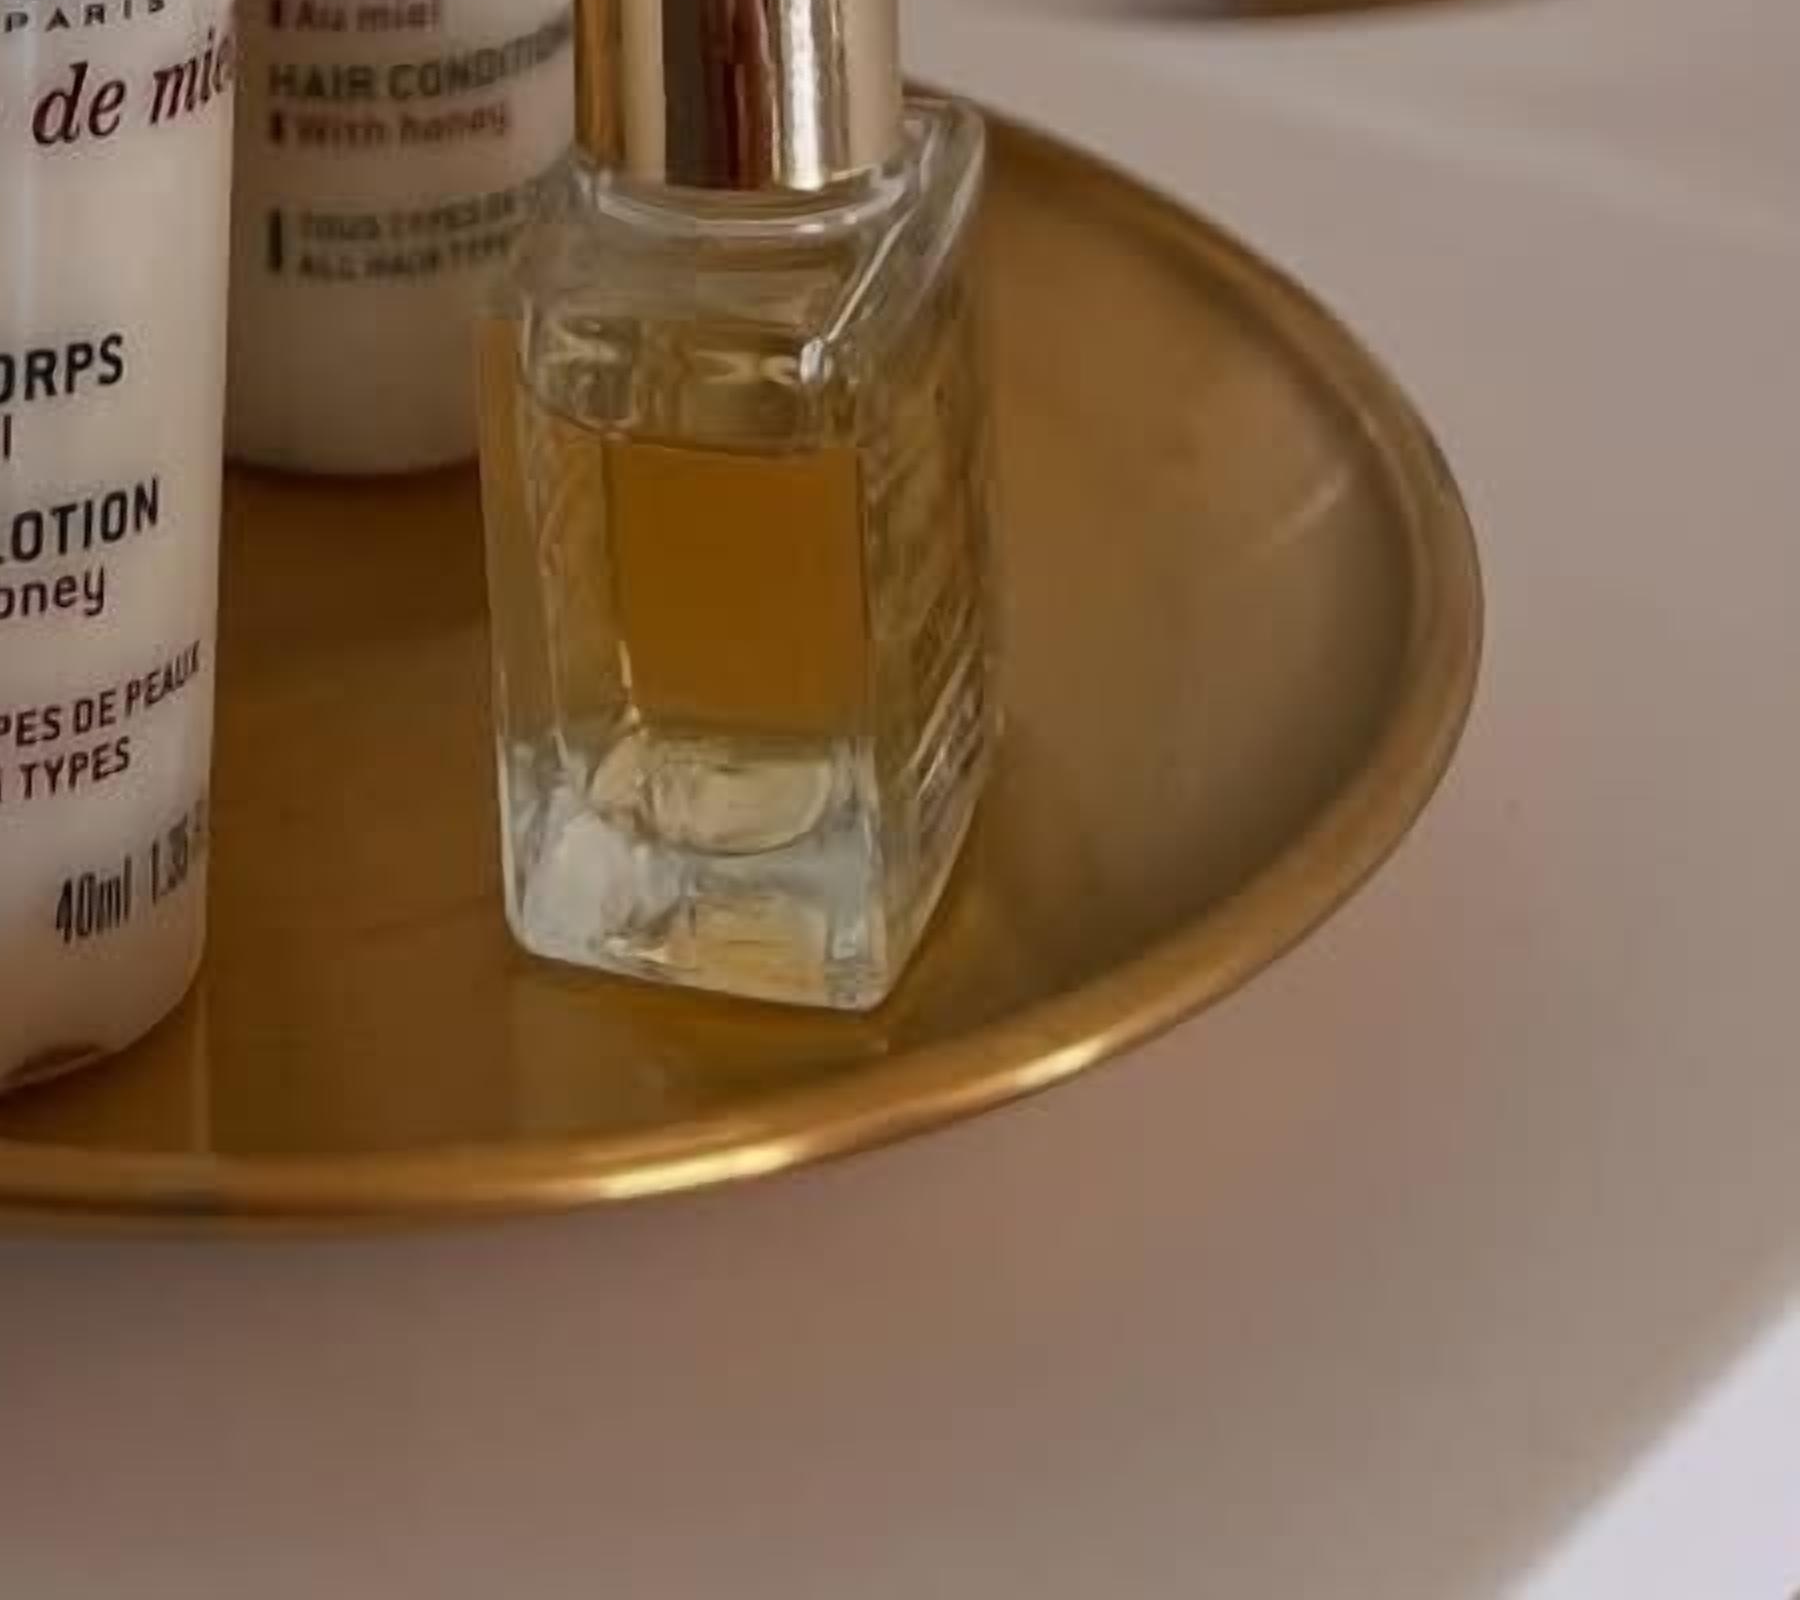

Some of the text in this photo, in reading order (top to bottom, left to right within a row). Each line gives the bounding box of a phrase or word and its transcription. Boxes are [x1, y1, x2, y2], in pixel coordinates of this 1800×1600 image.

[33, 62, 128, 145] de
[148, 28, 233, 127] mie
[267, 63, 377, 98] HAIR
[71, 688, 118, 736] DE
[126, 640, 203, 715] PEAUX
[18, 736, 132, 802] TYPES
[55, 855, 132, 945] 40ml
